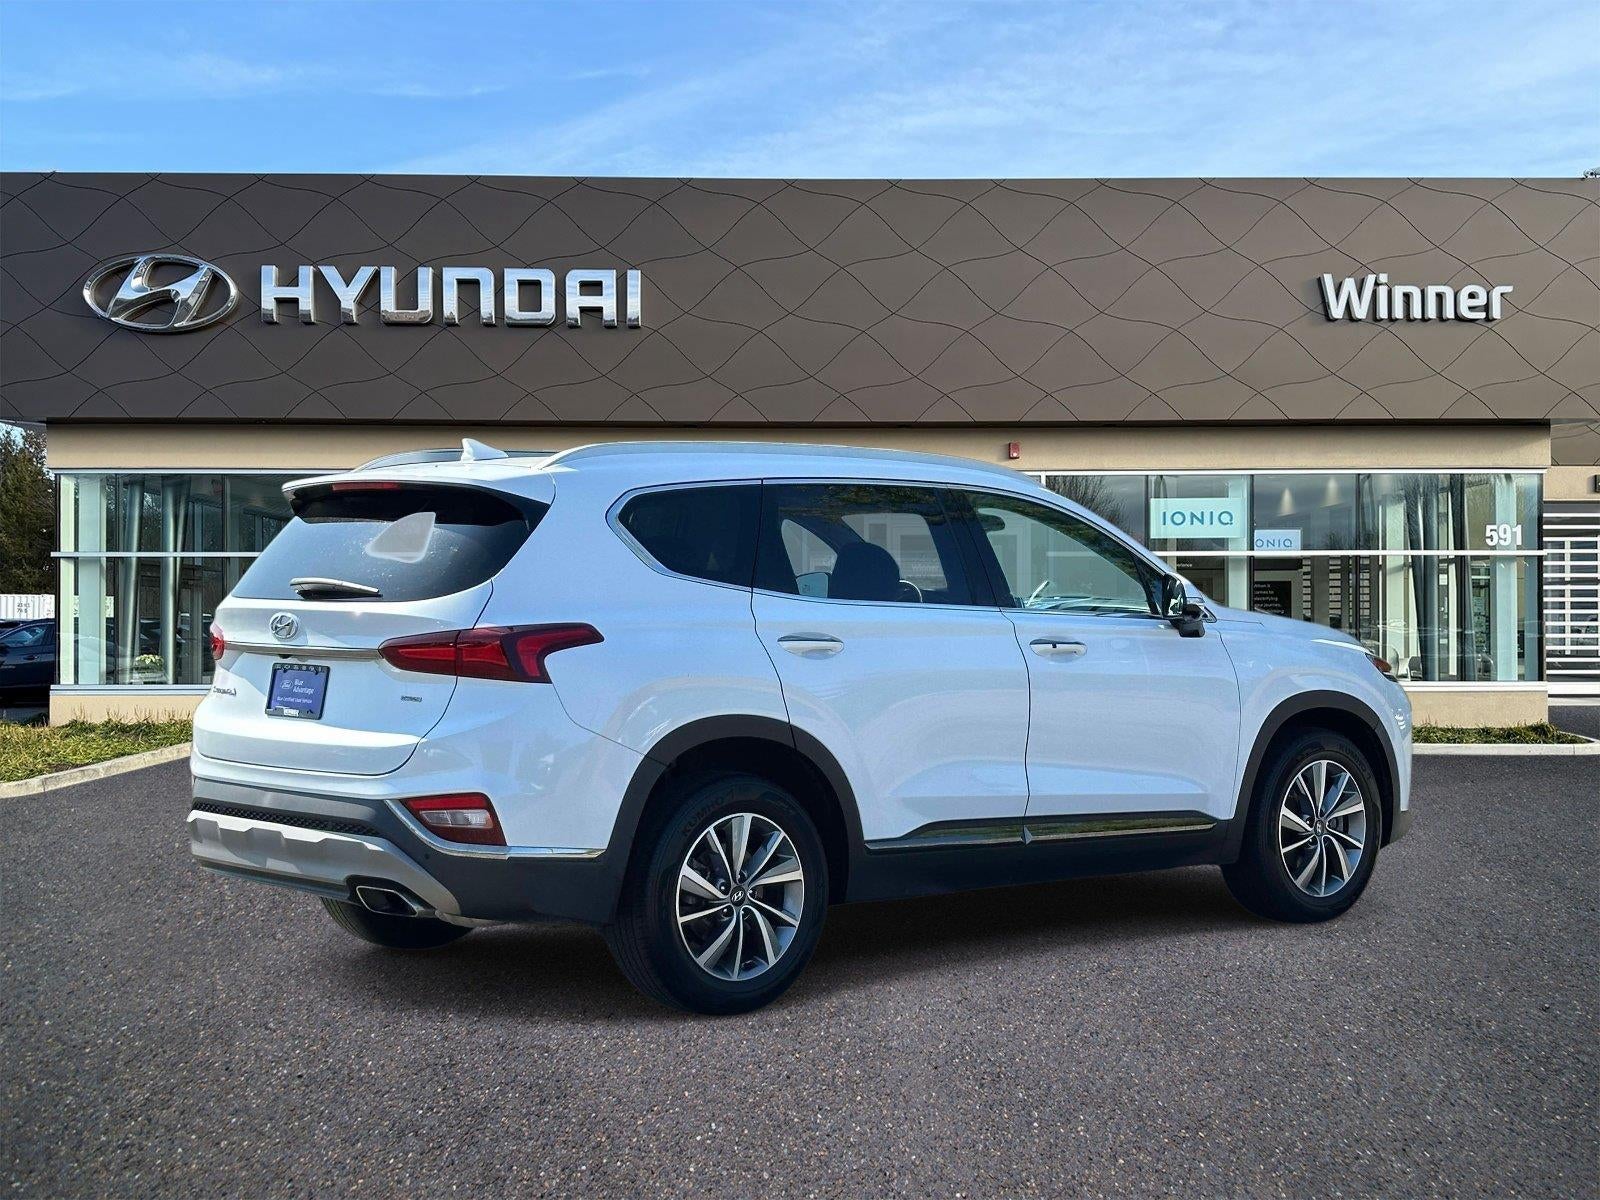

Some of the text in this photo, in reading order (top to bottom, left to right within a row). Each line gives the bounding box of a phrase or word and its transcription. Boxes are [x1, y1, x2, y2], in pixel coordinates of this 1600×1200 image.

[259, 264, 642, 328] HYUNDAI
[1317, 272, 1514, 321] Winner
[1162, 511, 1234, 526] IONIQ
[1254, 538, 1293, 548] ONIQ
[1485, 523, 1522, 546] 591
